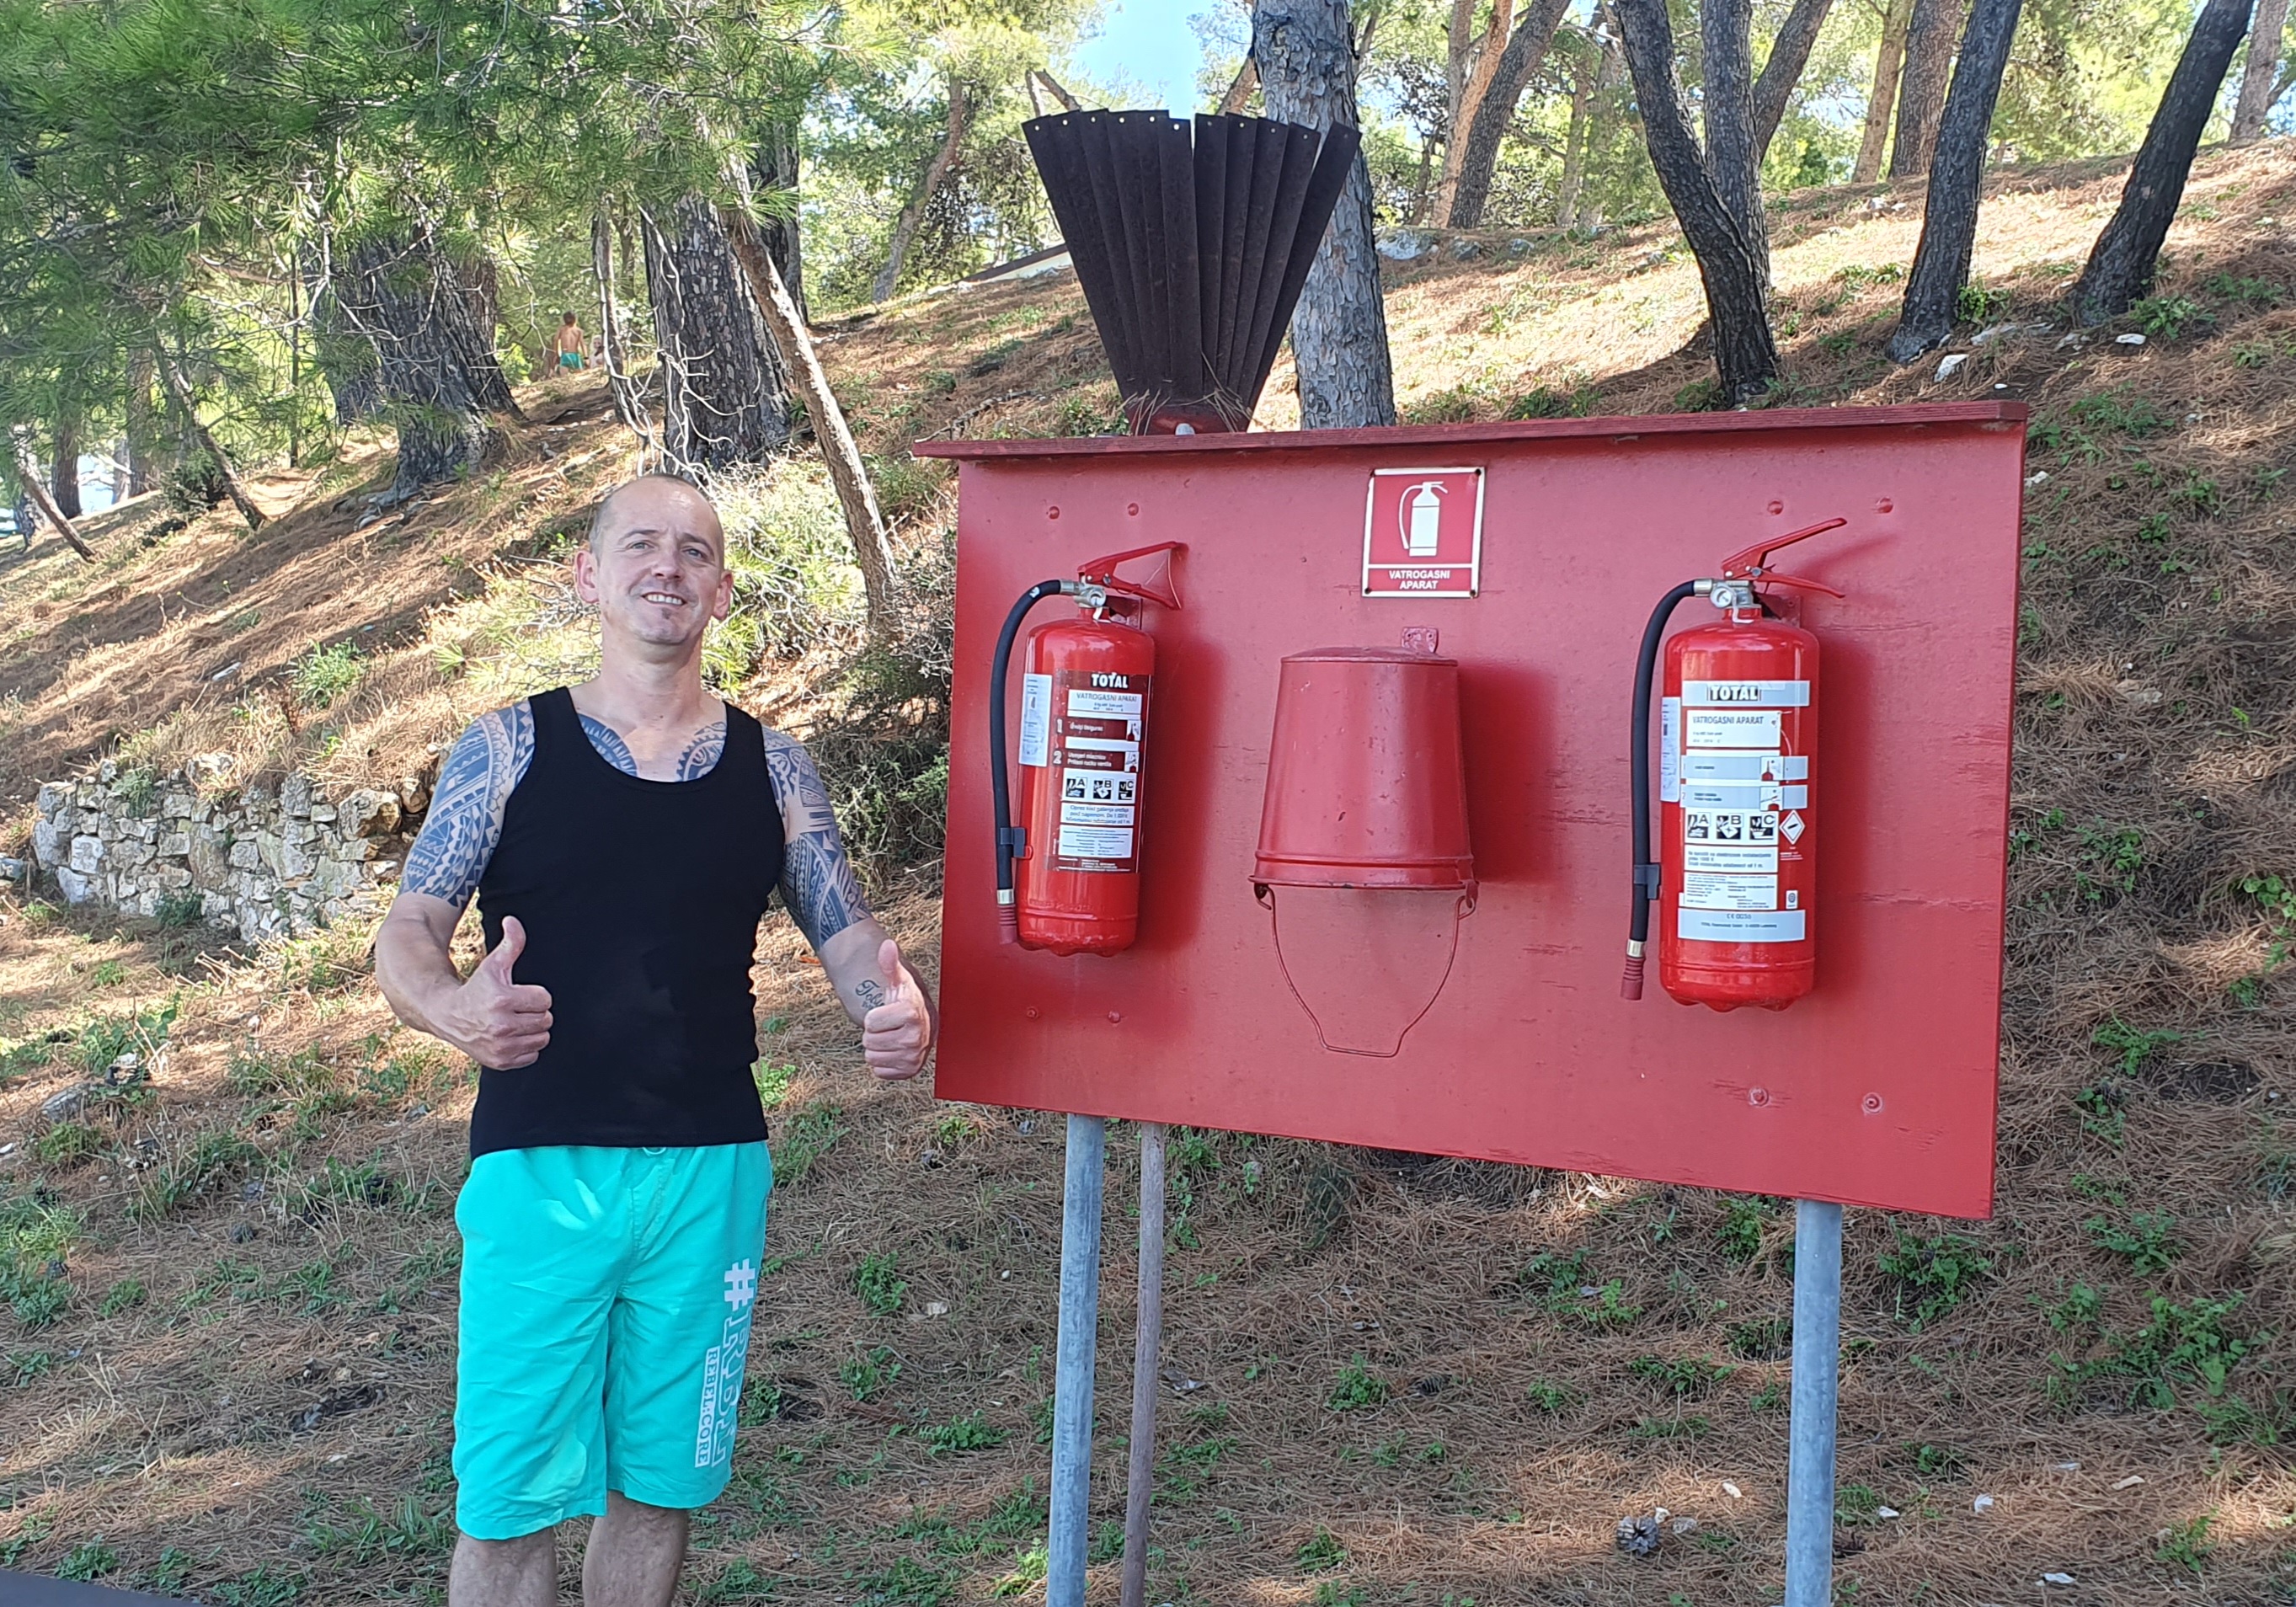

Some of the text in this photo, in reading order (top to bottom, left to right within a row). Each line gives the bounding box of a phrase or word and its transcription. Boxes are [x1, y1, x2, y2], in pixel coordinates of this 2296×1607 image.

[1389, 569, 1450, 579] VATROGASNI
[1399, 580, 1439, 590] APARAT
[1092, 673, 1129, 688] TOTAL
[1710, 686, 1758, 701] TOTAL
[1056, 718, 1063, 734] 1
[1736, 716, 1765, 724] APARAT
[1053, 750, 1062, 765] 2
[1077, 778, 1135, 788] A B C
[1699, 814, 1775, 825] A B C
[697, 1348, 720, 1466] REBEL:CORE
